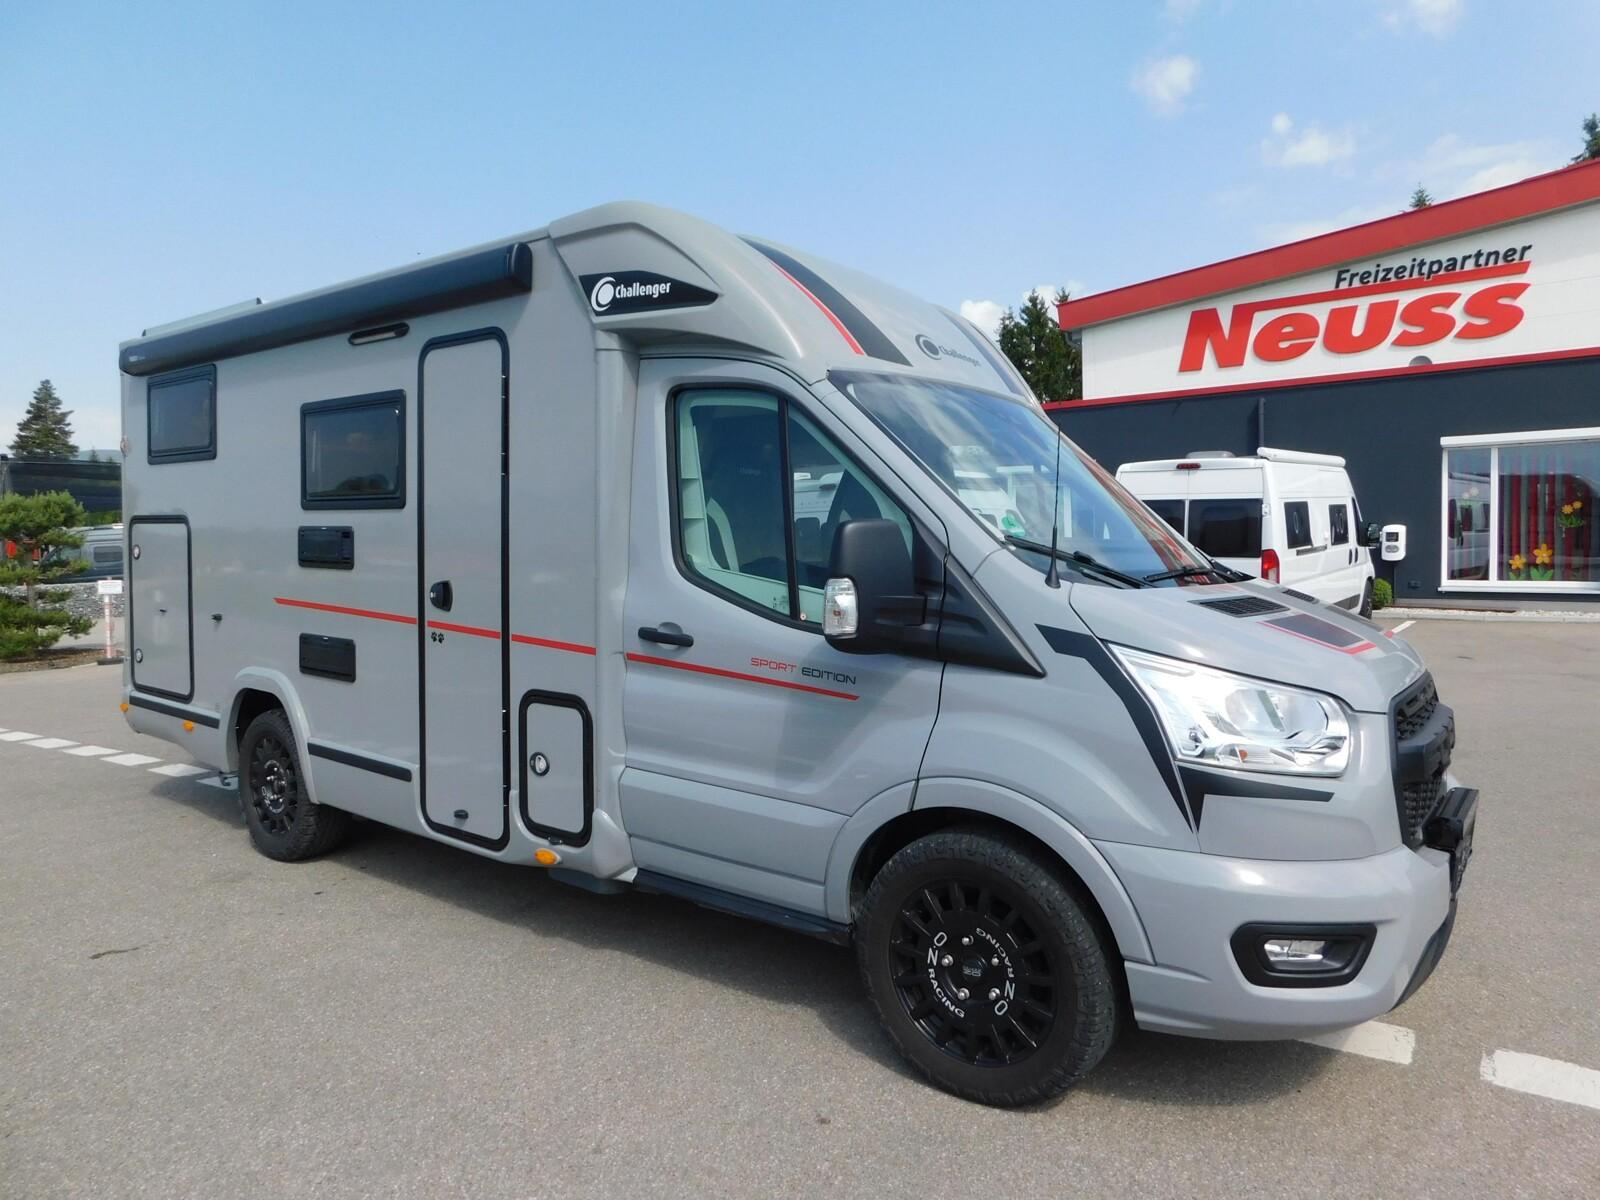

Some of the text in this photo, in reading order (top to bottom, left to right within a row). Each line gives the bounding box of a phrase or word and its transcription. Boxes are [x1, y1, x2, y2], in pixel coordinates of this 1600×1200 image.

[1334, 244, 1532, 289] Freizeitpartner
[615, 282, 671, 298] Challenger
[751, 657, 857, 685] SPORT EDITION
[975, 927, 1015, 978] RACING
[927, 968, 966, 1018] RACING
